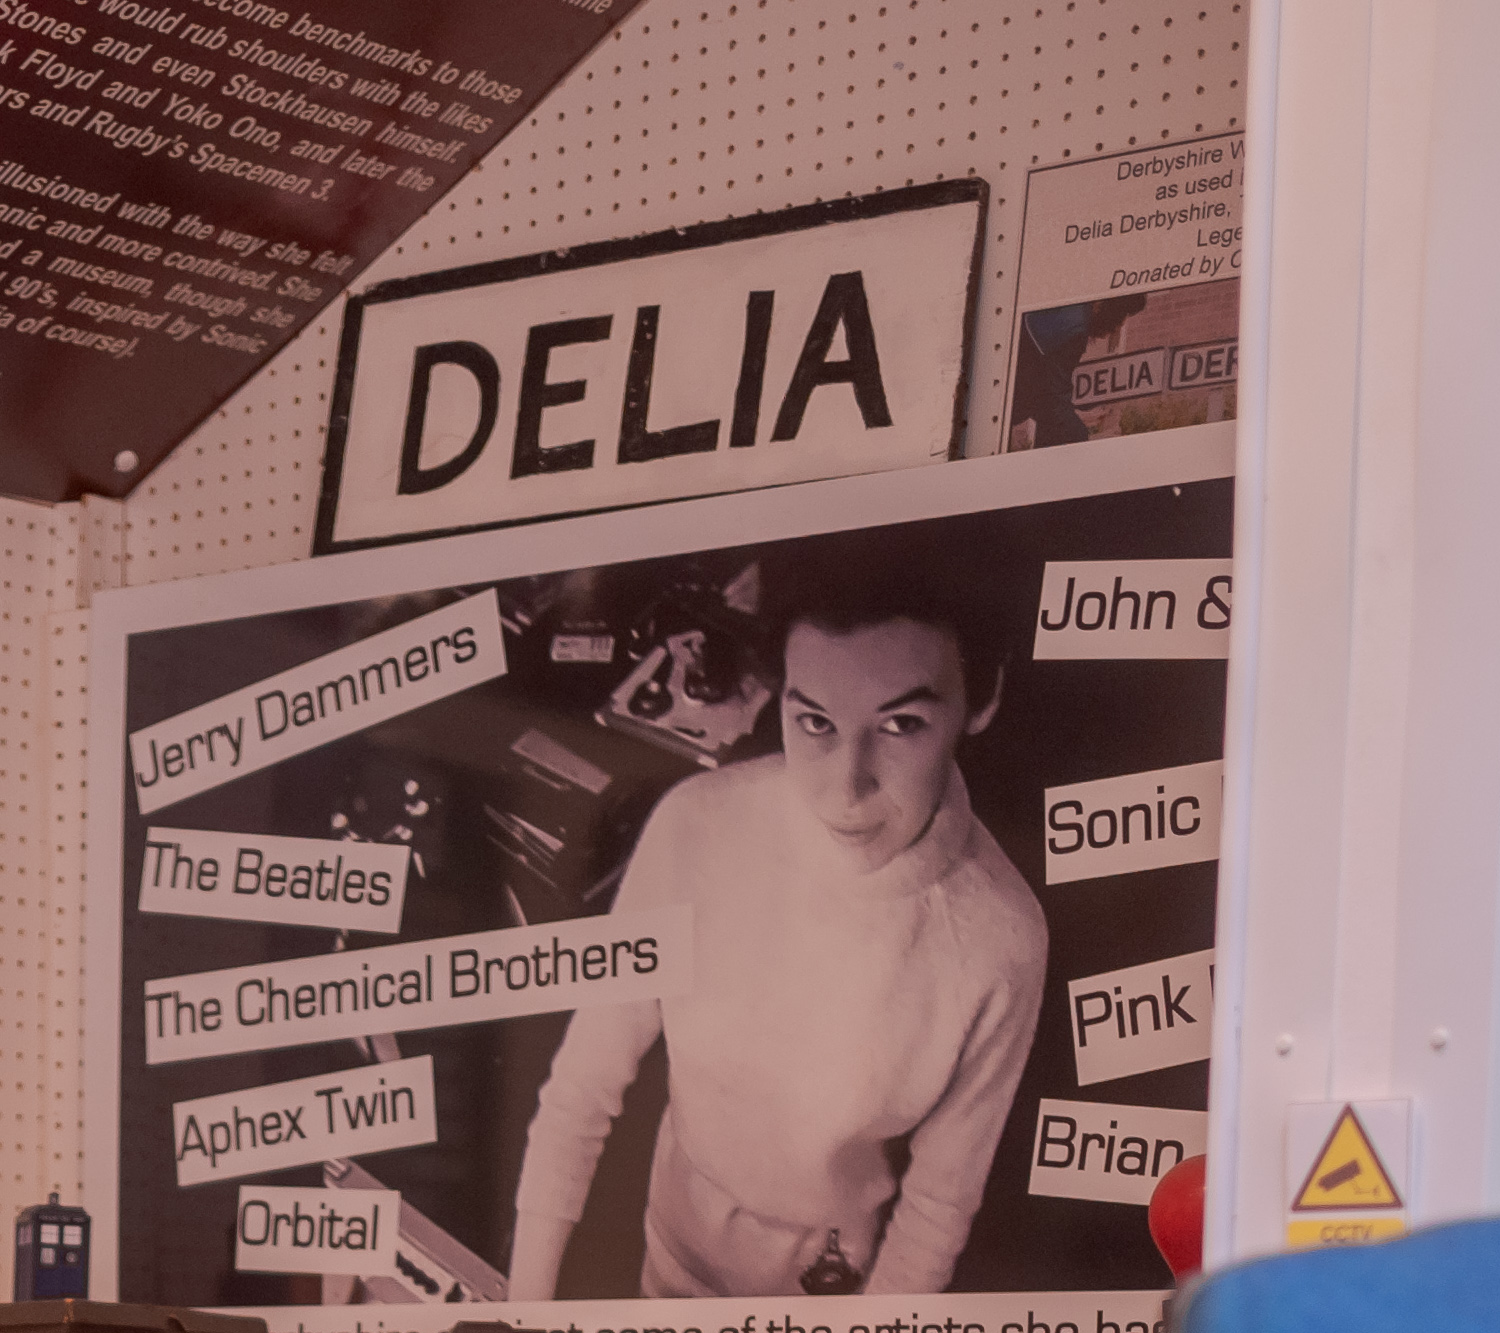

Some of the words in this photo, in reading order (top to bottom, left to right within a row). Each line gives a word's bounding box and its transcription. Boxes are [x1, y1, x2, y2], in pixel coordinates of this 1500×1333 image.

[1117, 147, 1223, 181] Derbyshire
[1155, 183, 1179, 201] as
[1185, 168, 1233, 195] used
[117, 202, 172, 229] with
[172, 214, 215, 240] the
[217, 229, 267, 258] way
[265, 241, 311, 265] she
[310, 250, 355, 276] felt
[1065, 219, 1113, 244] Delia
[1119, 201, 1231, 234] Derbyshire,
[1109, 257, 1196, 290] Donated
[1198, 255, 1225, 277] by
[397, 271, 894, 497] DELIA
[1075, 360, 1154, 400] DELIA
[1037, 568, 1177, 632] John
[1197, 575, 1229, 630] &
[131, 717, 243, 811] Jerry
[256, 626, 477, 742] Dammers
[1048, 785, 1201, 855] Sonic
[140, 836, 219, 892] The
[233, 848, 392, 906] Beatles
[141, 984, 222, 1059] The
[236, 954, 432, 1027] Chemical
[450, 936, 658, 999] Brothers
[1075, 974, 1197, 1048] Pink
[173, 1106, 307, 1179] Aphex
[315, 1077, 415, 1134] Twin
[1039, 1116, 1184, 1179] Brian
[236, 1194, 379, 1251] Orbital
